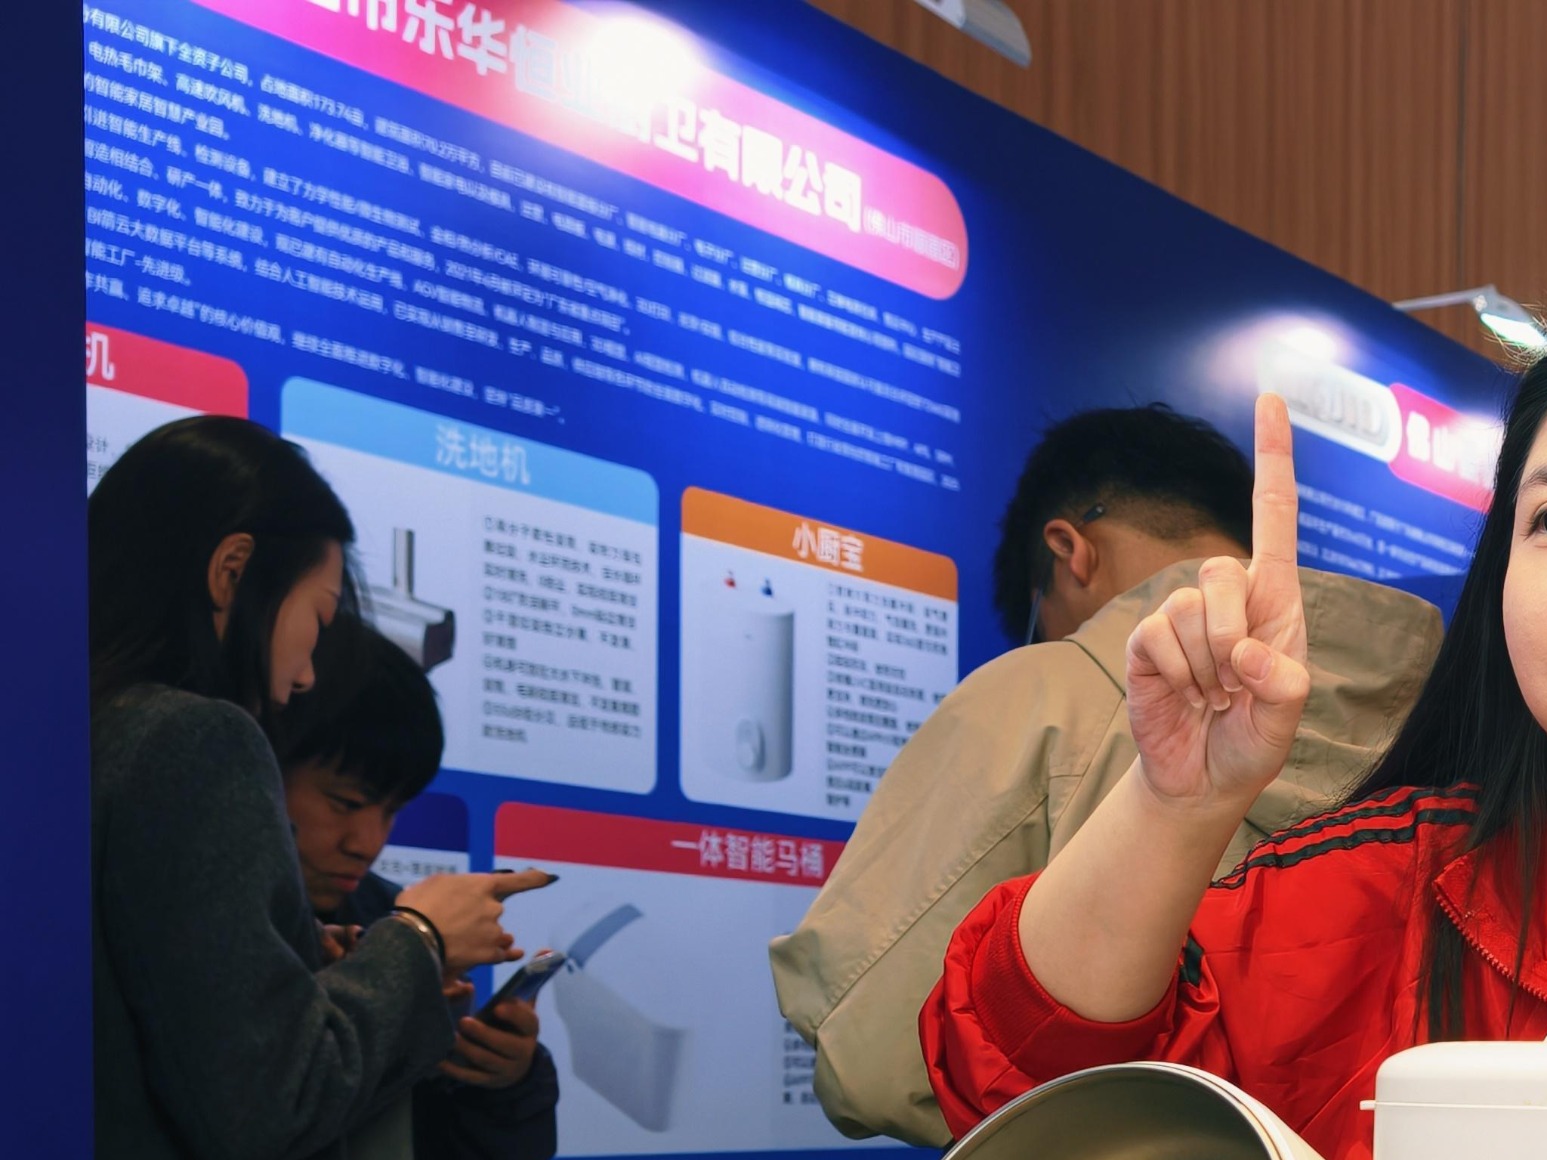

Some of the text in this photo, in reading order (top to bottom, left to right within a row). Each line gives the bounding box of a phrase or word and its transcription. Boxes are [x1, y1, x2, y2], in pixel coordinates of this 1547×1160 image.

[434, 422, 532, 485] 洗地机
[792, 522, 864, 572] 小厨宝
[671, 829, 825, 878] 一体智能马桶
